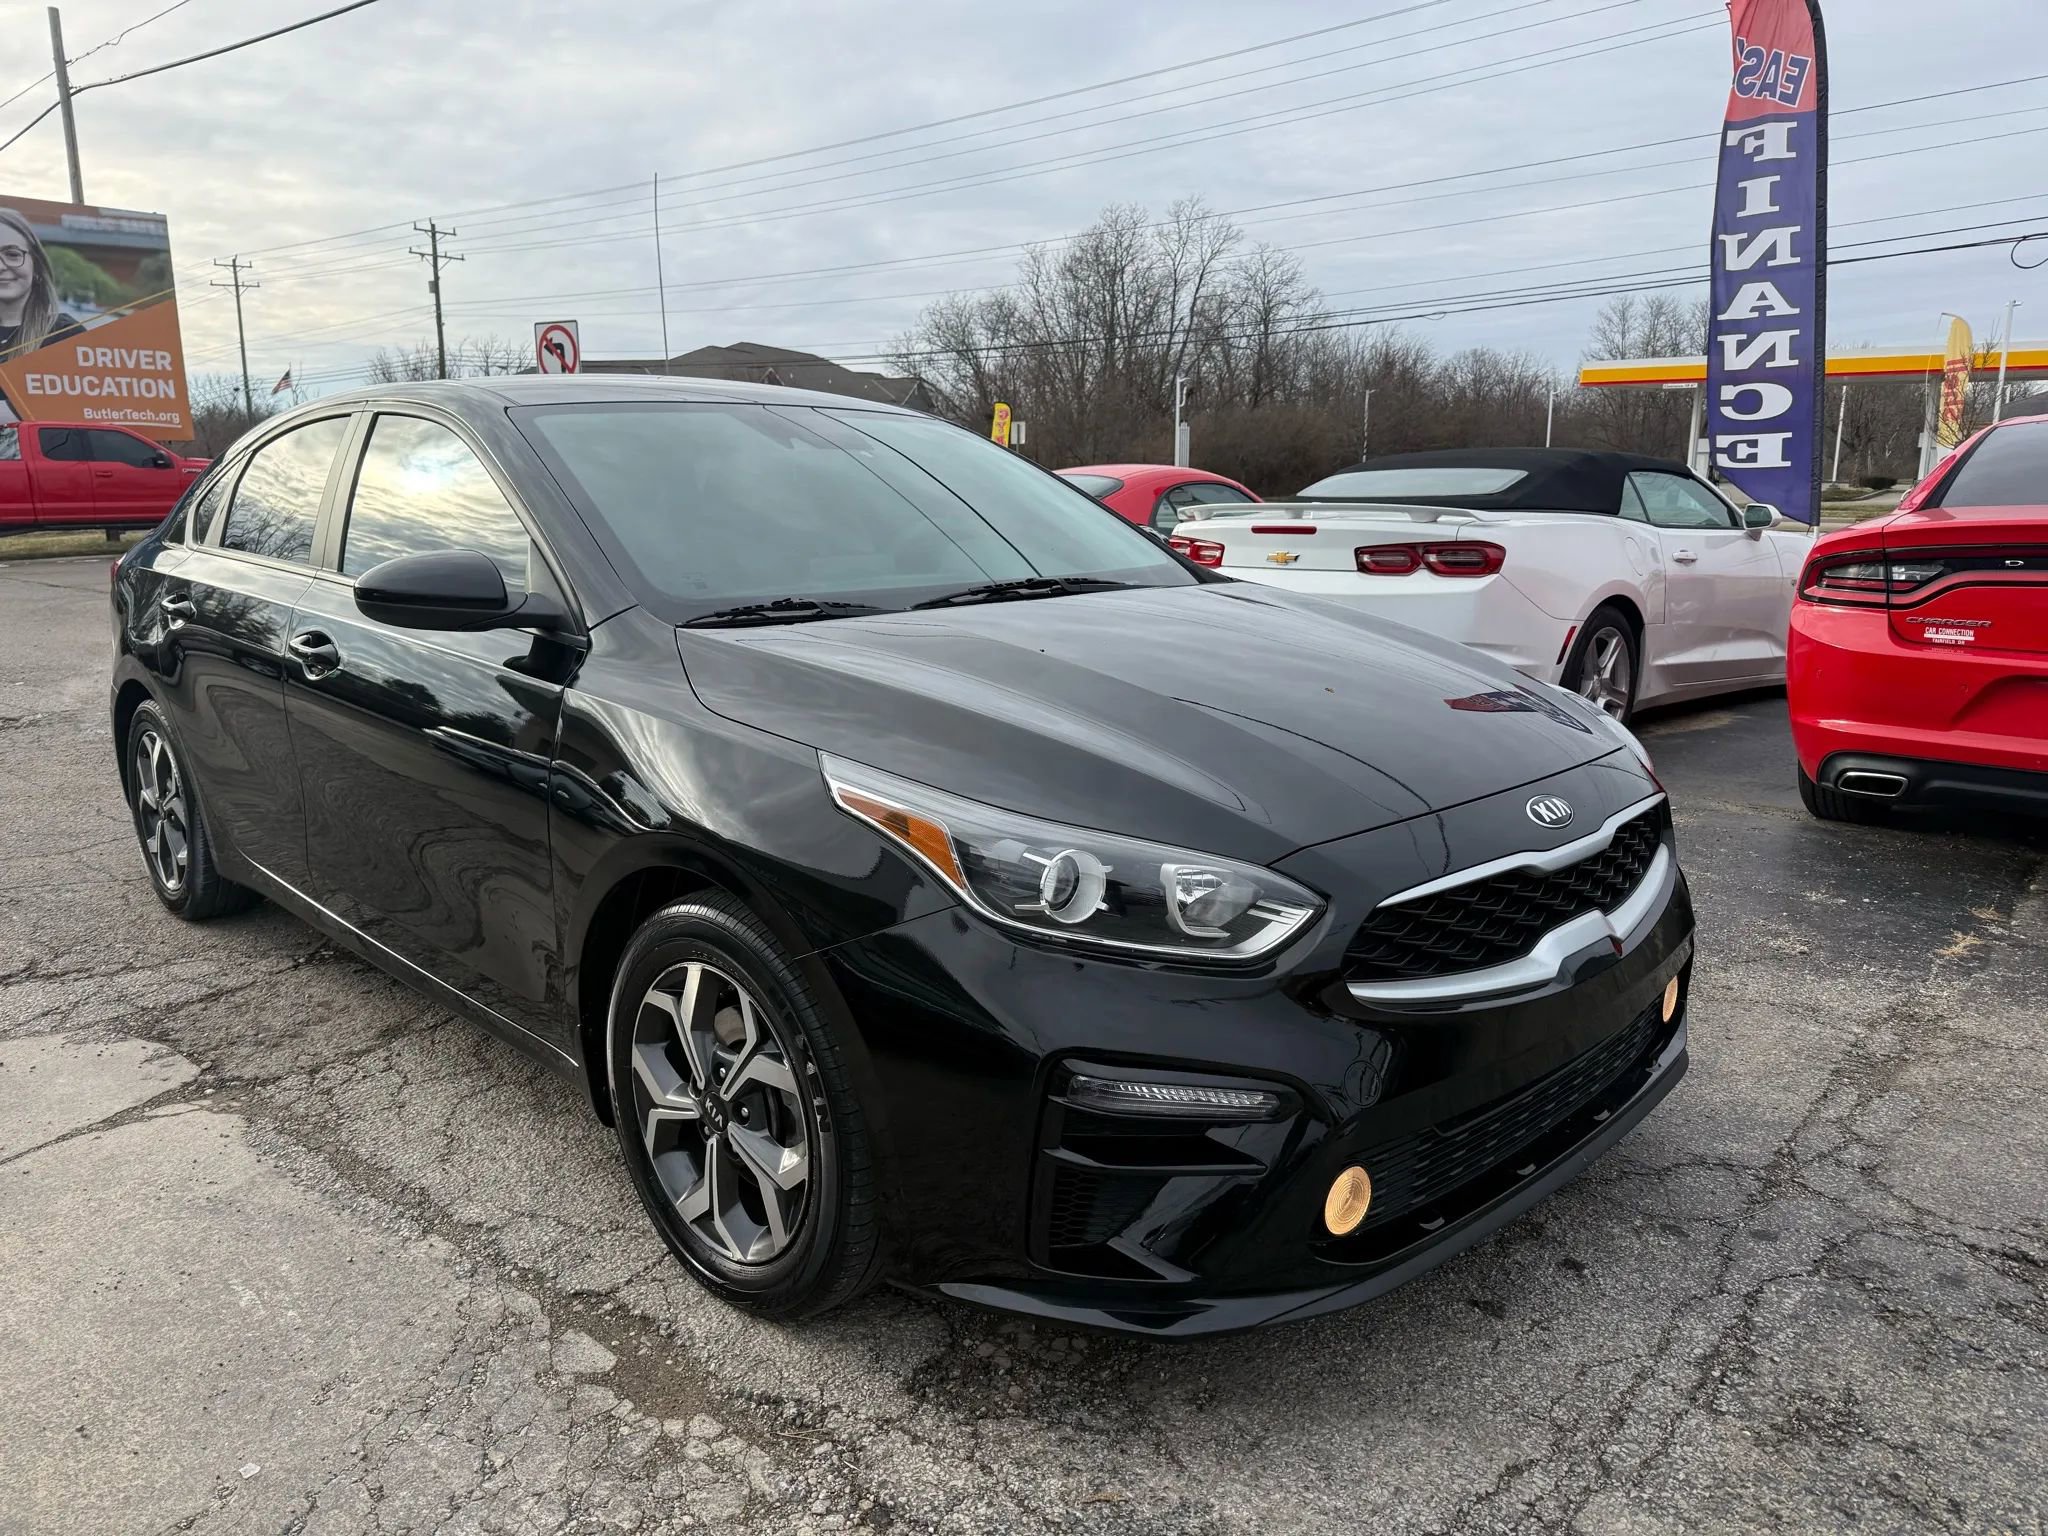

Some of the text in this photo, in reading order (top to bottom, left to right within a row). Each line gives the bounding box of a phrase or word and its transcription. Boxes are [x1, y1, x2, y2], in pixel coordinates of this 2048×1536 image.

[76, 346, 172, 371] DRIVER
[25, 373, 176, 399] EDUCATION
[84, 408, 180, 424] ButlerTech.org
[1906, 616, 1991, 627] CHARGER
[1925, 626, 1975, 637] CAR CONNECTION
[1532, 798, 1571, 823] KIA
[705, 1097, 723, 1128] KIA
